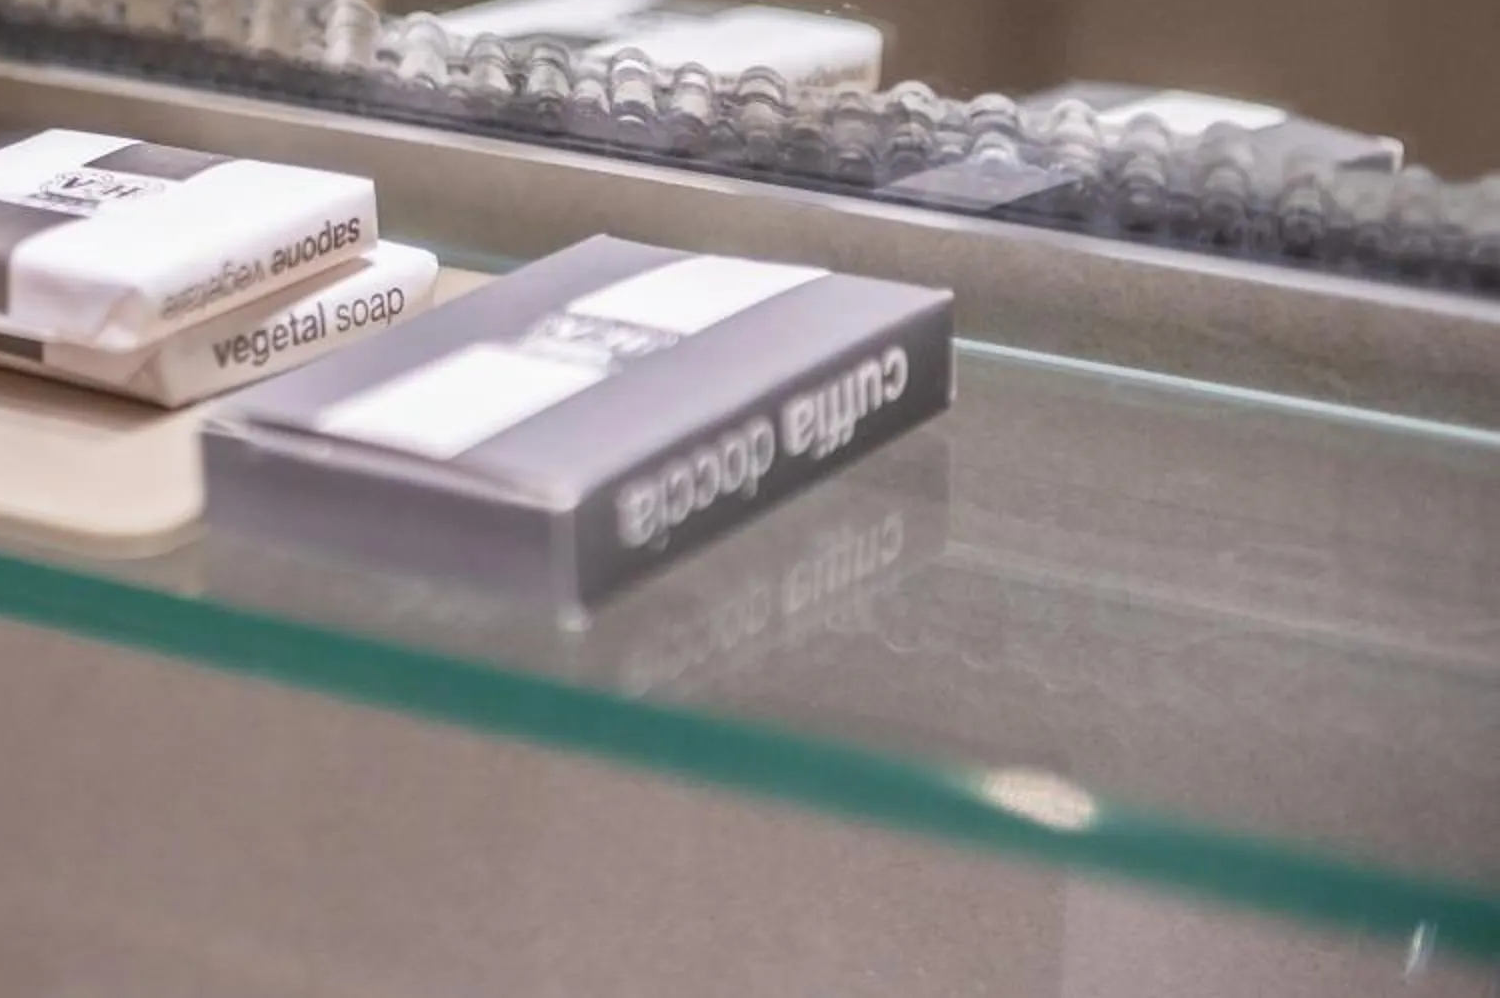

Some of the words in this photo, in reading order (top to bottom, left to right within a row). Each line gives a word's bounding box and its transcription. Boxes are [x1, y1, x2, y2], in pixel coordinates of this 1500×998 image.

[270, 216, 361, 277] sapone
[211, 300, 327, 368] vegetal
[336, 286, 405, 333] soap
[781, 346, 909, 460] cuffia
[617, 415, 775, 551] doccia
